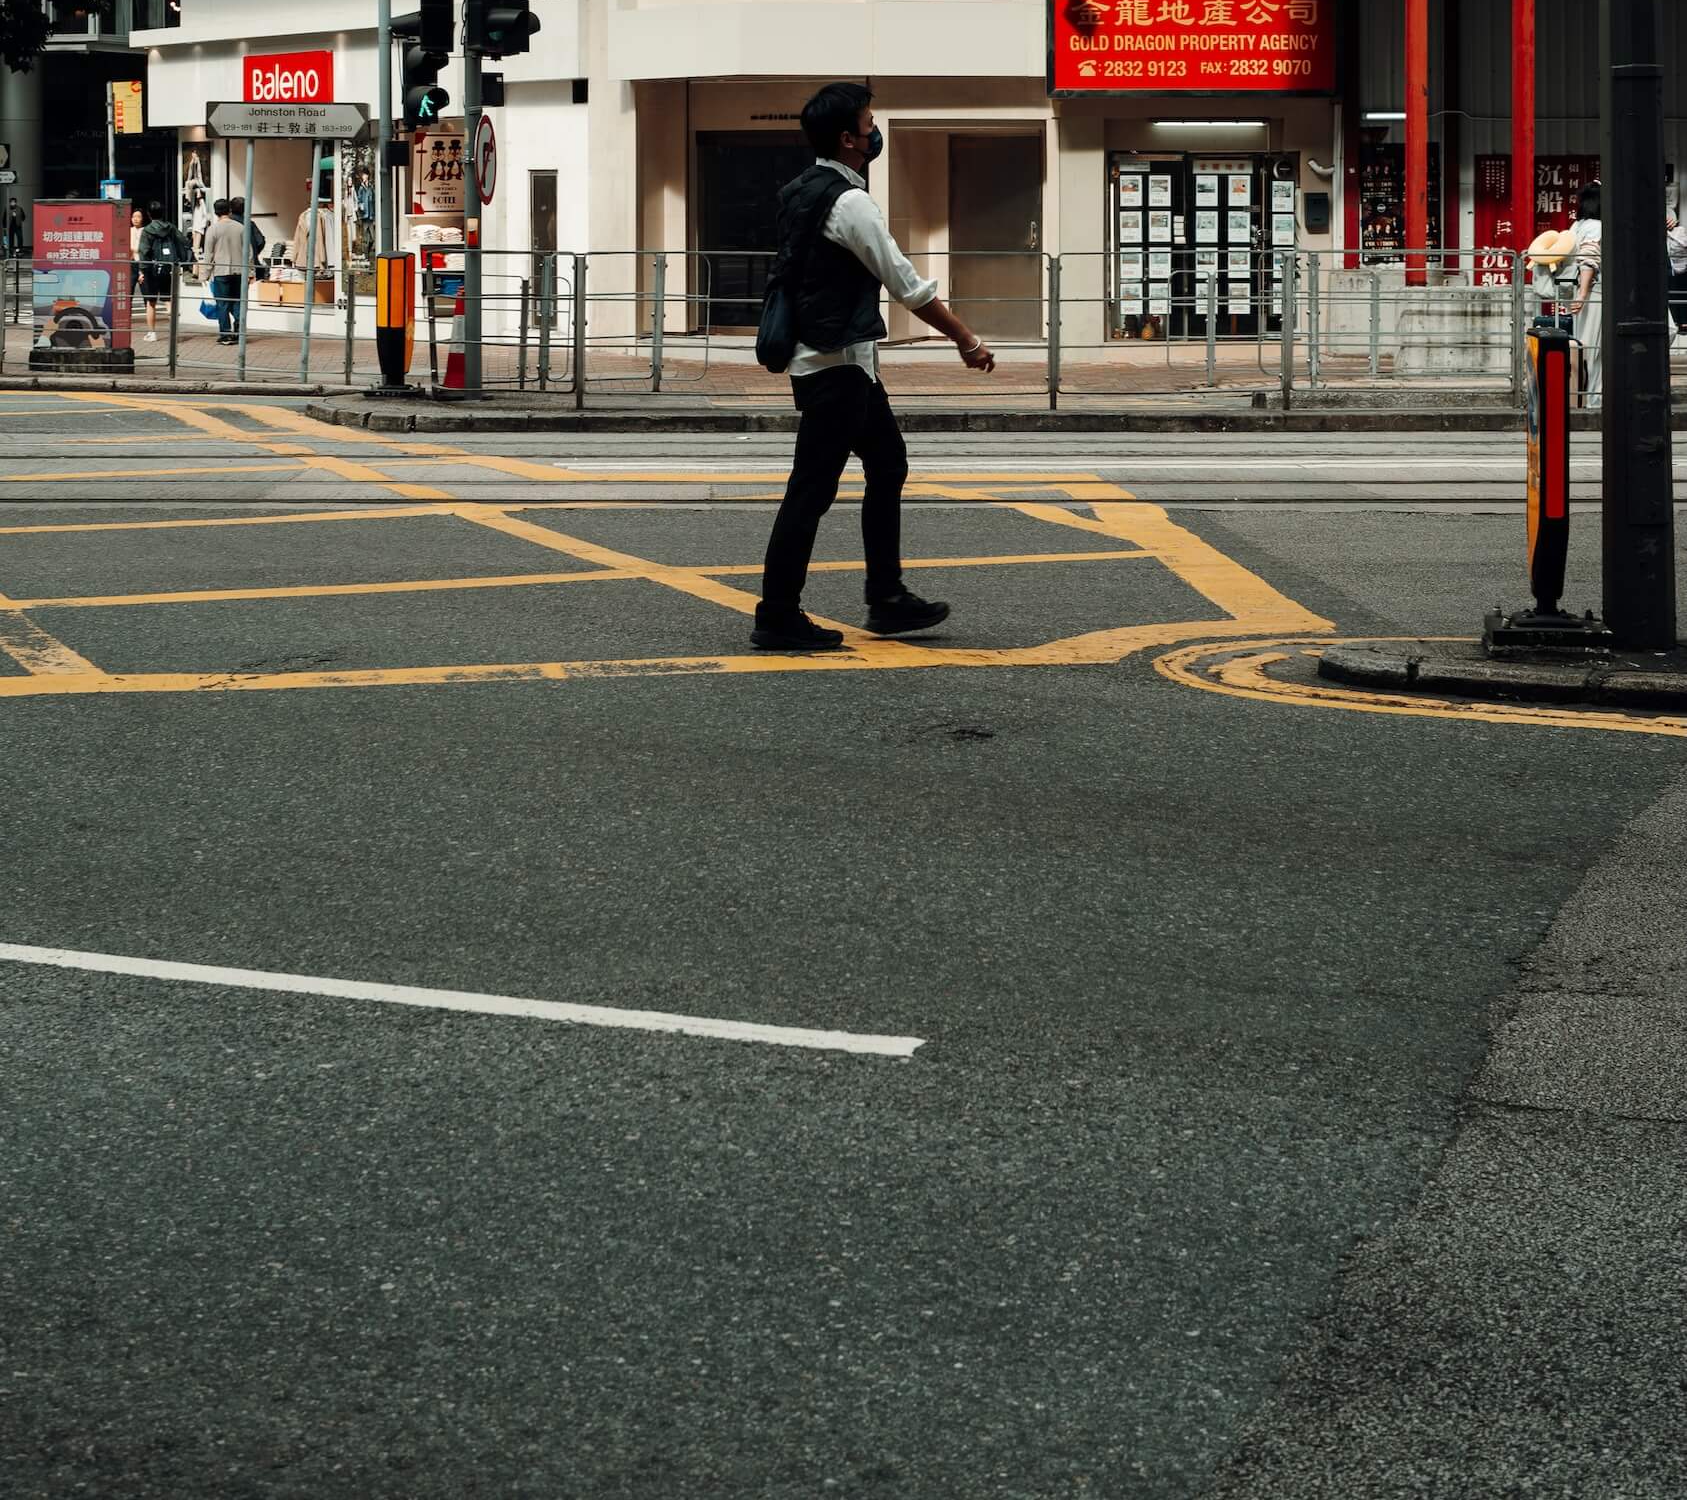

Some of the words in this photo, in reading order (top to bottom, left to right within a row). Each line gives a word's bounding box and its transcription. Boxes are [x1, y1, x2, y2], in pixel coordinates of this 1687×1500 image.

[1070, 34, 1110, 51] GOLD
[1114, 34, 1176, 51] DRAGON
[1180, 34, 1257, 51] PROPERTY
[1260, 34, 1319, 51] AGENCY
[1147, 60, 1187, 77] 9123
[1229, 59, 1269, 76] 2832
[1272, 59, 1312, 76] 9070
[252, 63, 319, 101] Baleno
[249, 107, 296, 118] Johnston
[298, 107, 326, 117] Road
[1537, 164, 1563, 213] 沉船
